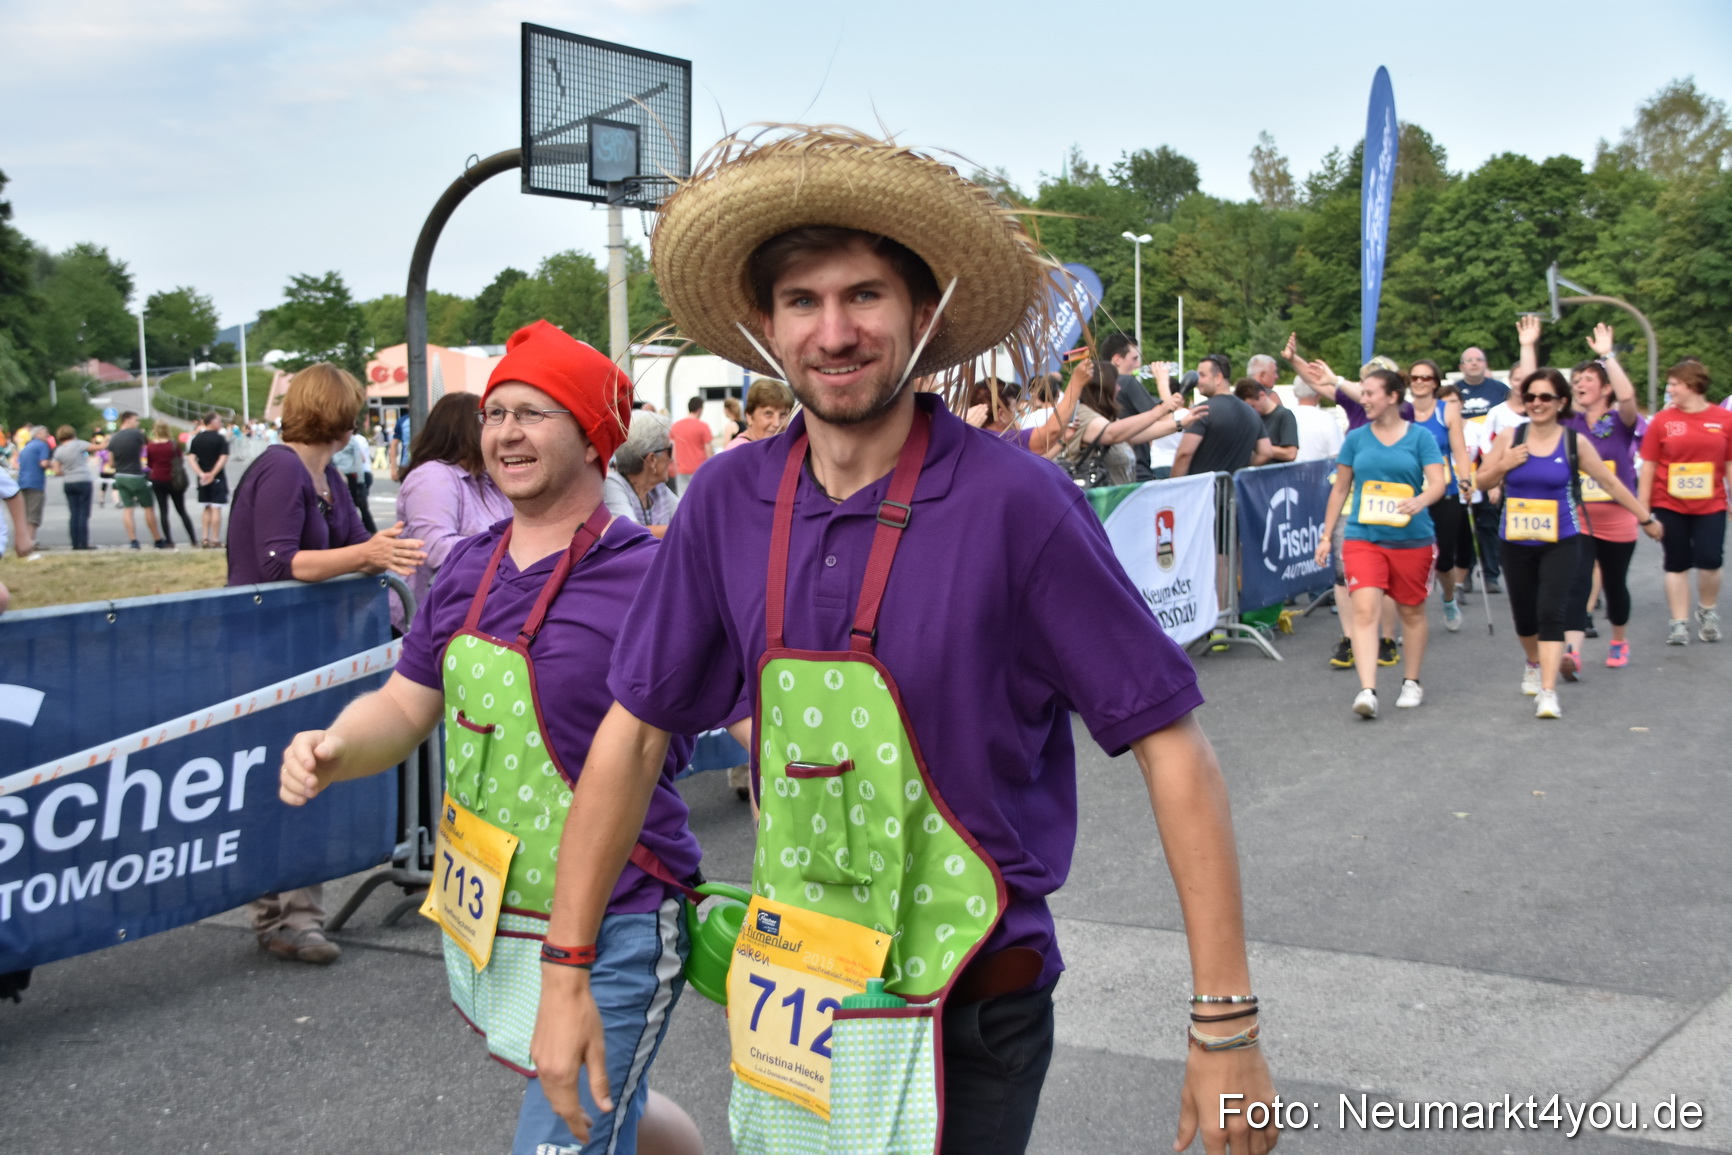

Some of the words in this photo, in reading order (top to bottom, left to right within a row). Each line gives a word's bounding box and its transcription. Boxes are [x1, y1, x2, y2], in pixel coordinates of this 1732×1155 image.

[1677, 477, 1705, 489] 852
[1367, 498, 1404, 515] 110
[1512, 516, 1551, 531] 1104
[443, 850, 484, 920] 713
[747, 924, 803, 952] firmenlauf
[802, 951, 835, 970] 2015
[748, 972, 841, 1060] 712
[750, 1046, 793, 1071] Christina
[795, 1061, 824, 1084] Hiecke
